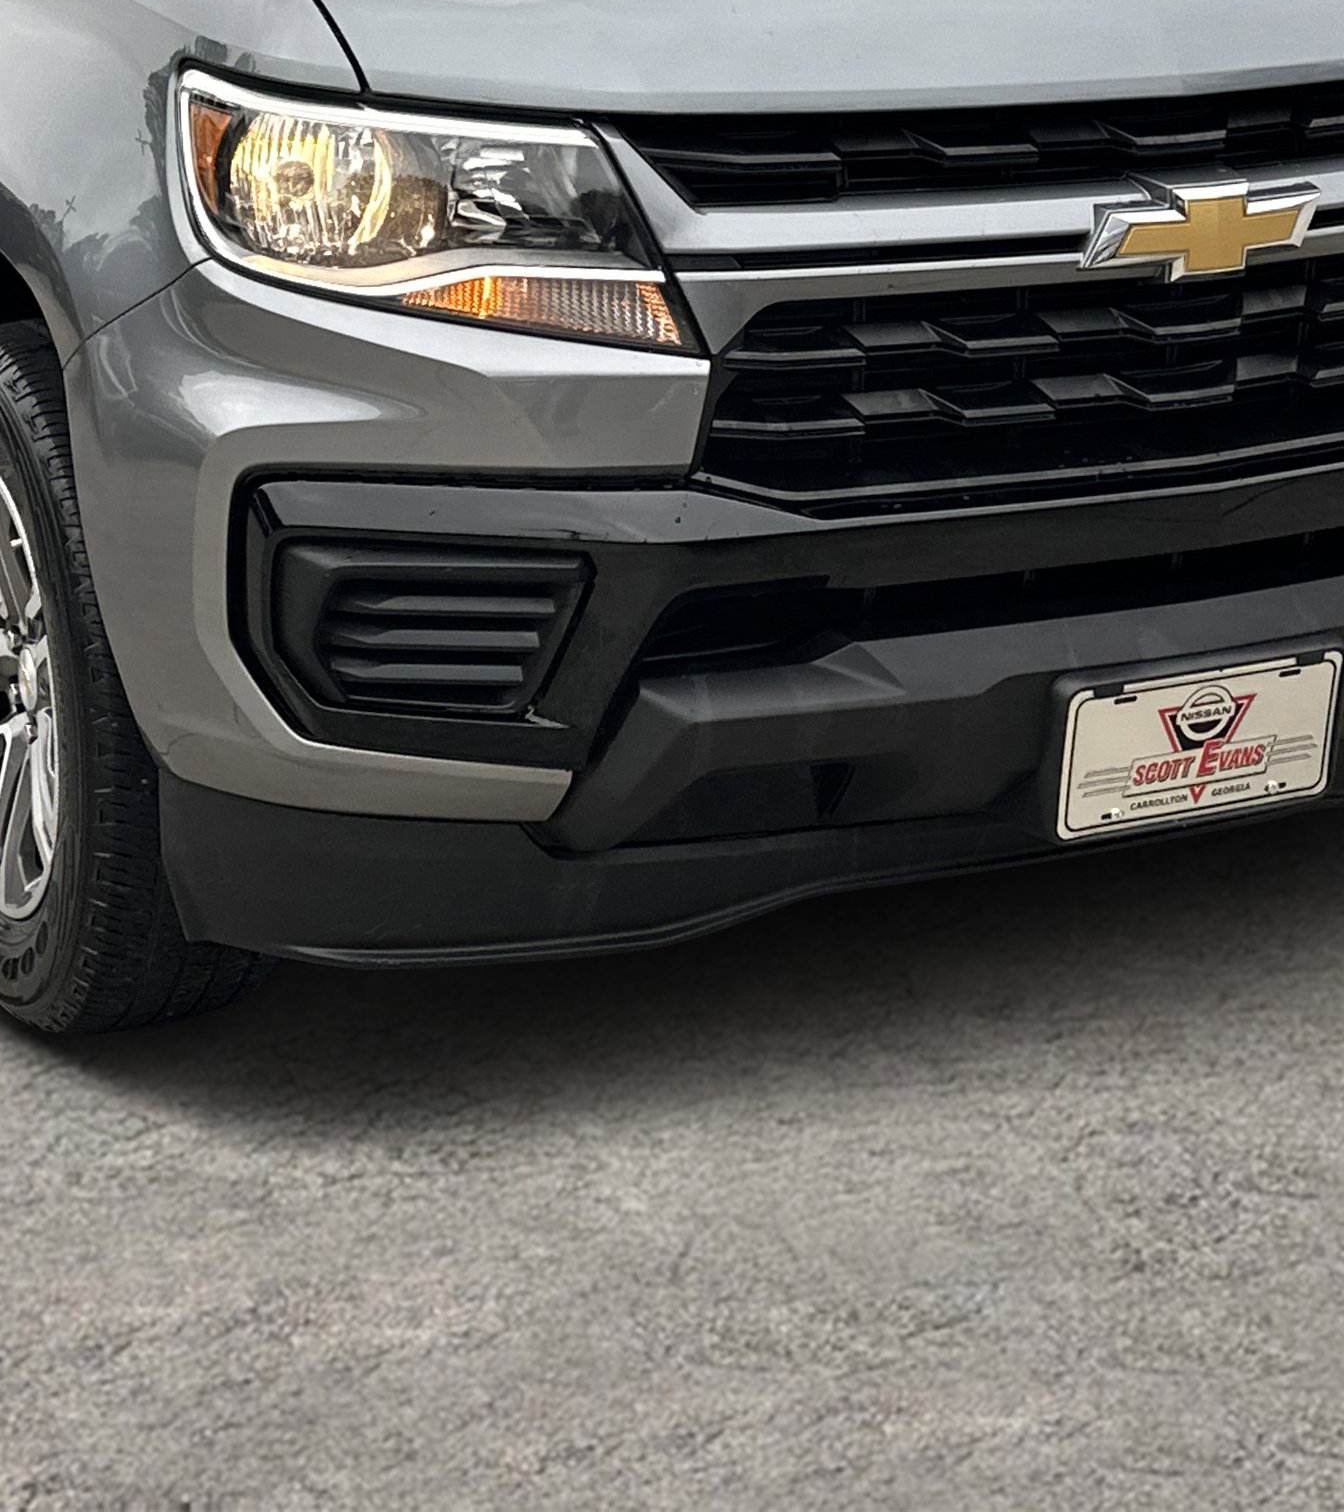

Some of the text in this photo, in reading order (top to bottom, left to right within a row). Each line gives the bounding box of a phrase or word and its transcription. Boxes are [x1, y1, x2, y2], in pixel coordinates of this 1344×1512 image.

[1181, 705, 1232, 722] NISSAN
[1132, 738, 1265, 786] SCOTT EVANS
[1130, 783, 1250, 810] CARROLLTON GEORGIA
